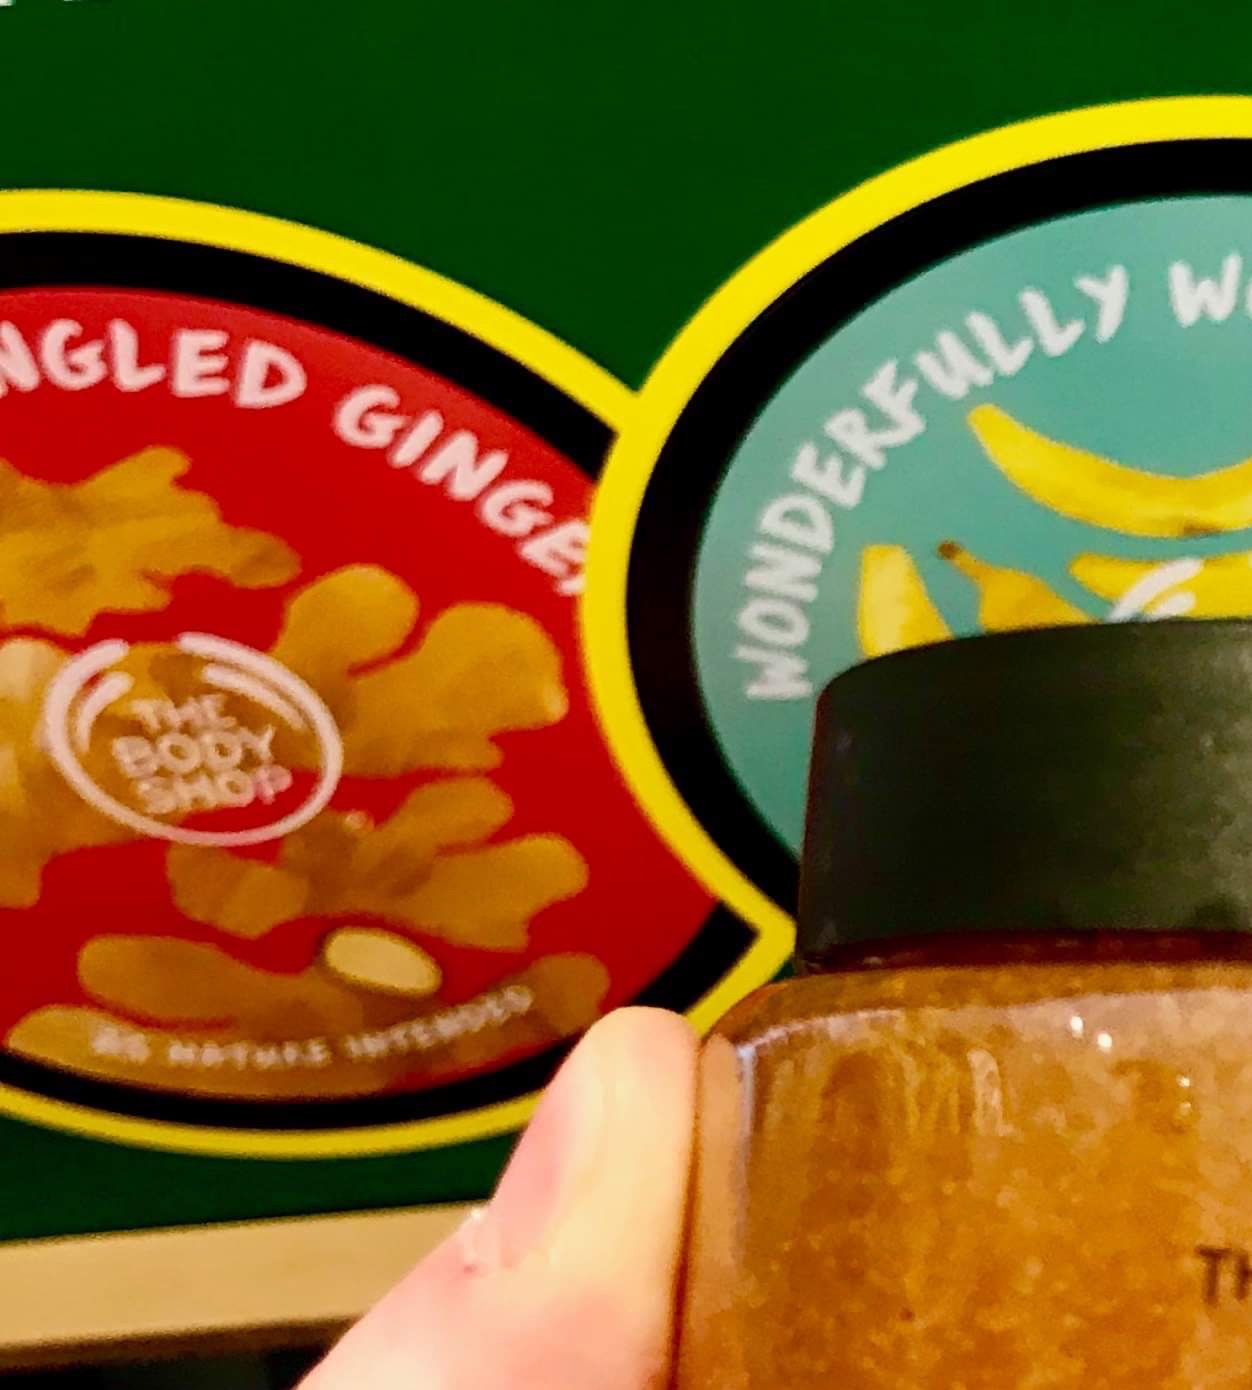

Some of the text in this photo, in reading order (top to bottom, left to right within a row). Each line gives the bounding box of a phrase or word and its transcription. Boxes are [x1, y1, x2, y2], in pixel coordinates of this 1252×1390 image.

[333, 384, 589, 597] GINGE
[735, 264, 1129, 701] WONDERFULLY
[112, 724, 276, 780] BODY
[134, 764, 293, 815] SHOP
